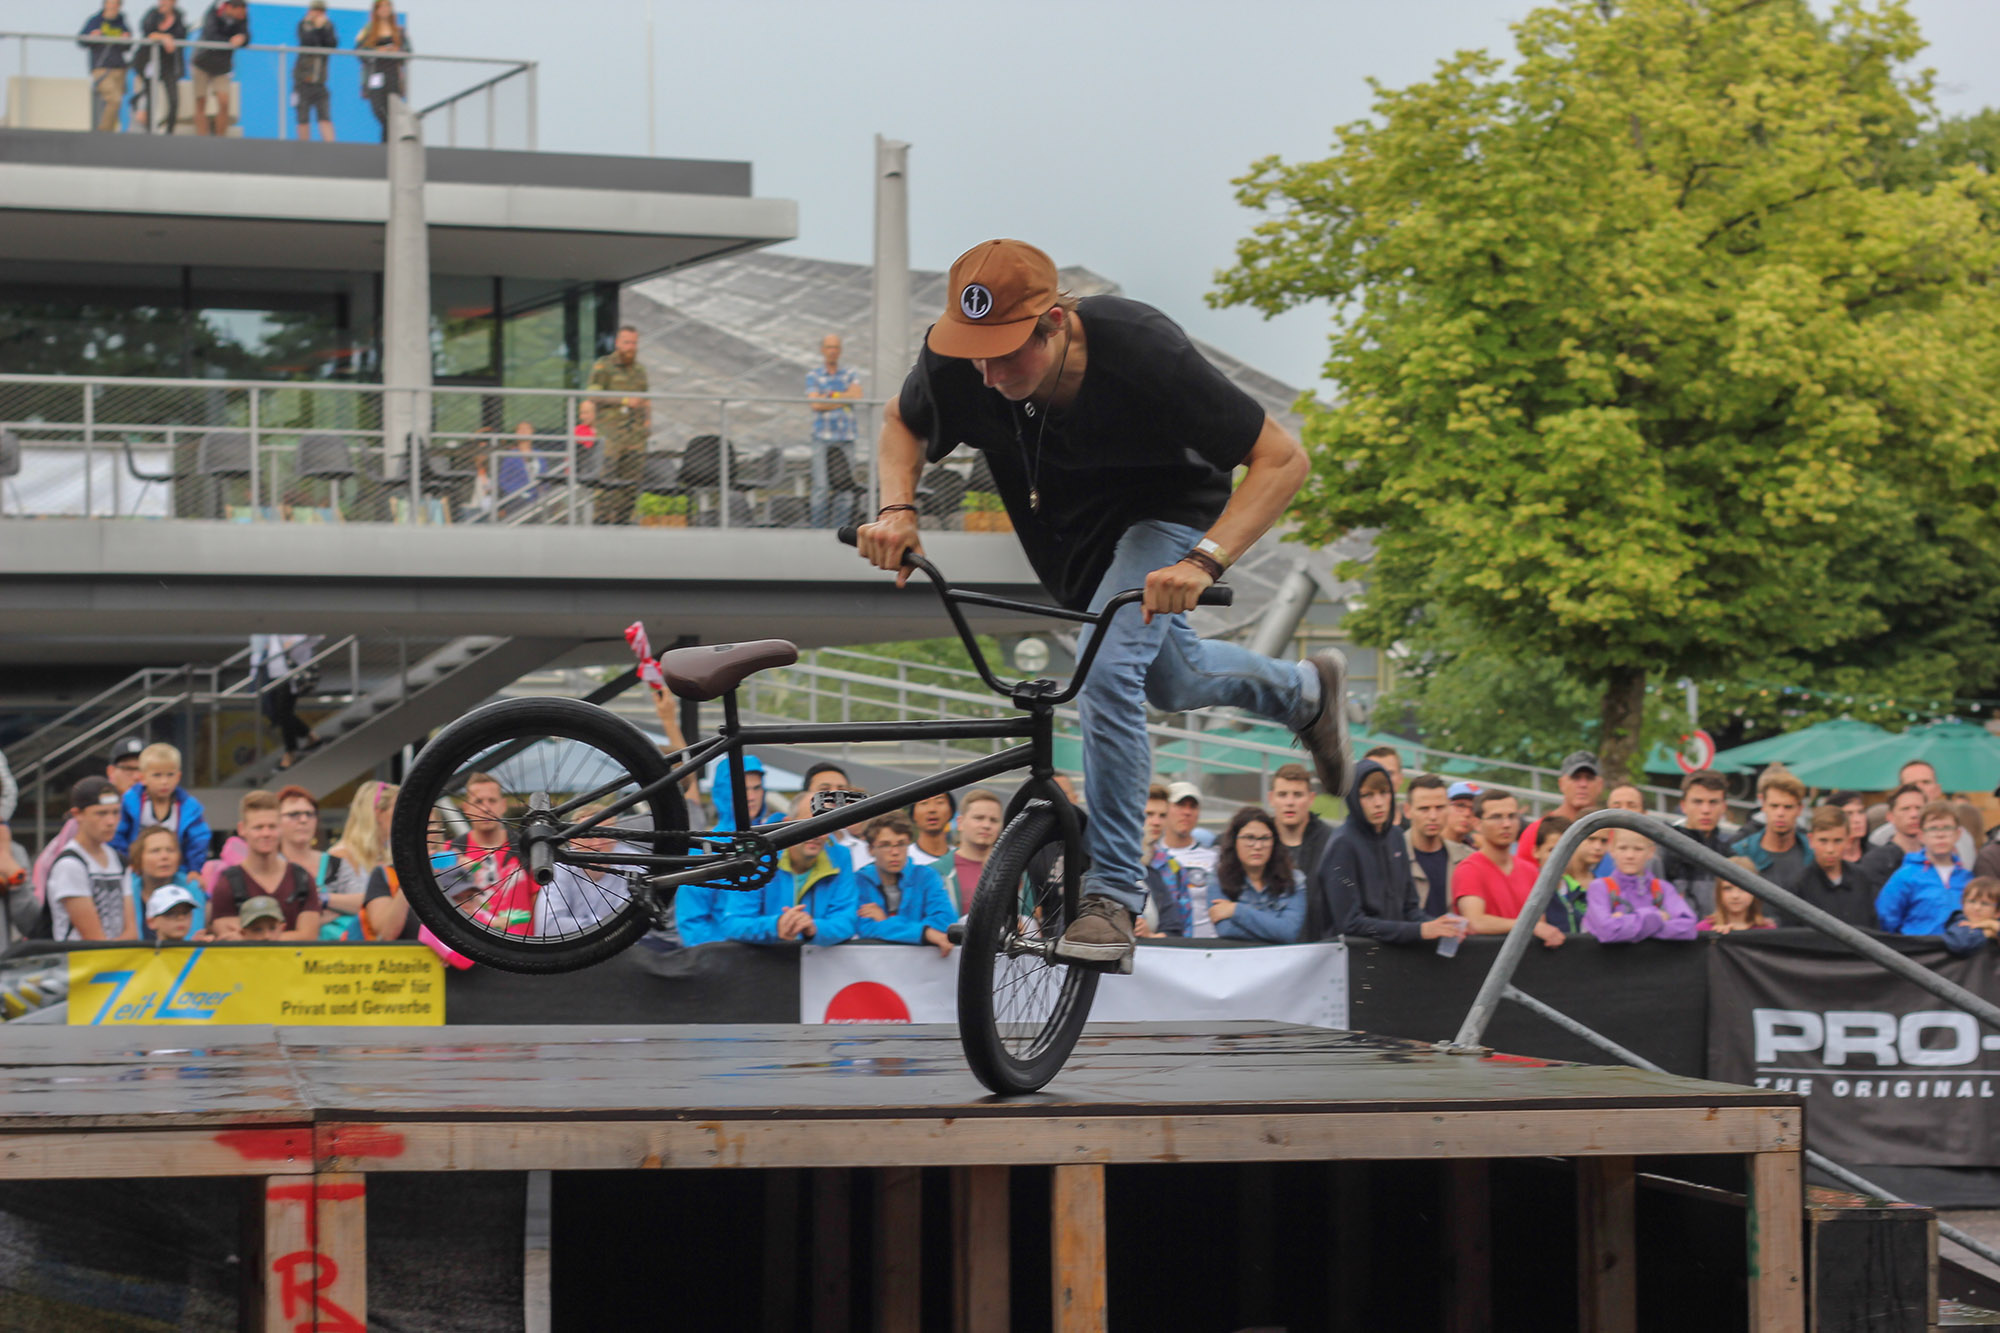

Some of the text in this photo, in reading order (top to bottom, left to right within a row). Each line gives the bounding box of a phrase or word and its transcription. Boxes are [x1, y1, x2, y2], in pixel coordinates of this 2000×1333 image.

[304, 960, 431, 974] Mietbare Abteile
[324, 984, 350, 994] von
[411, 979, 432, 993] für
[281, 1000, 431, 1015] Privat und Gewerbe
[1754, 1077, 1995, 1098] THE ORIGINAL
